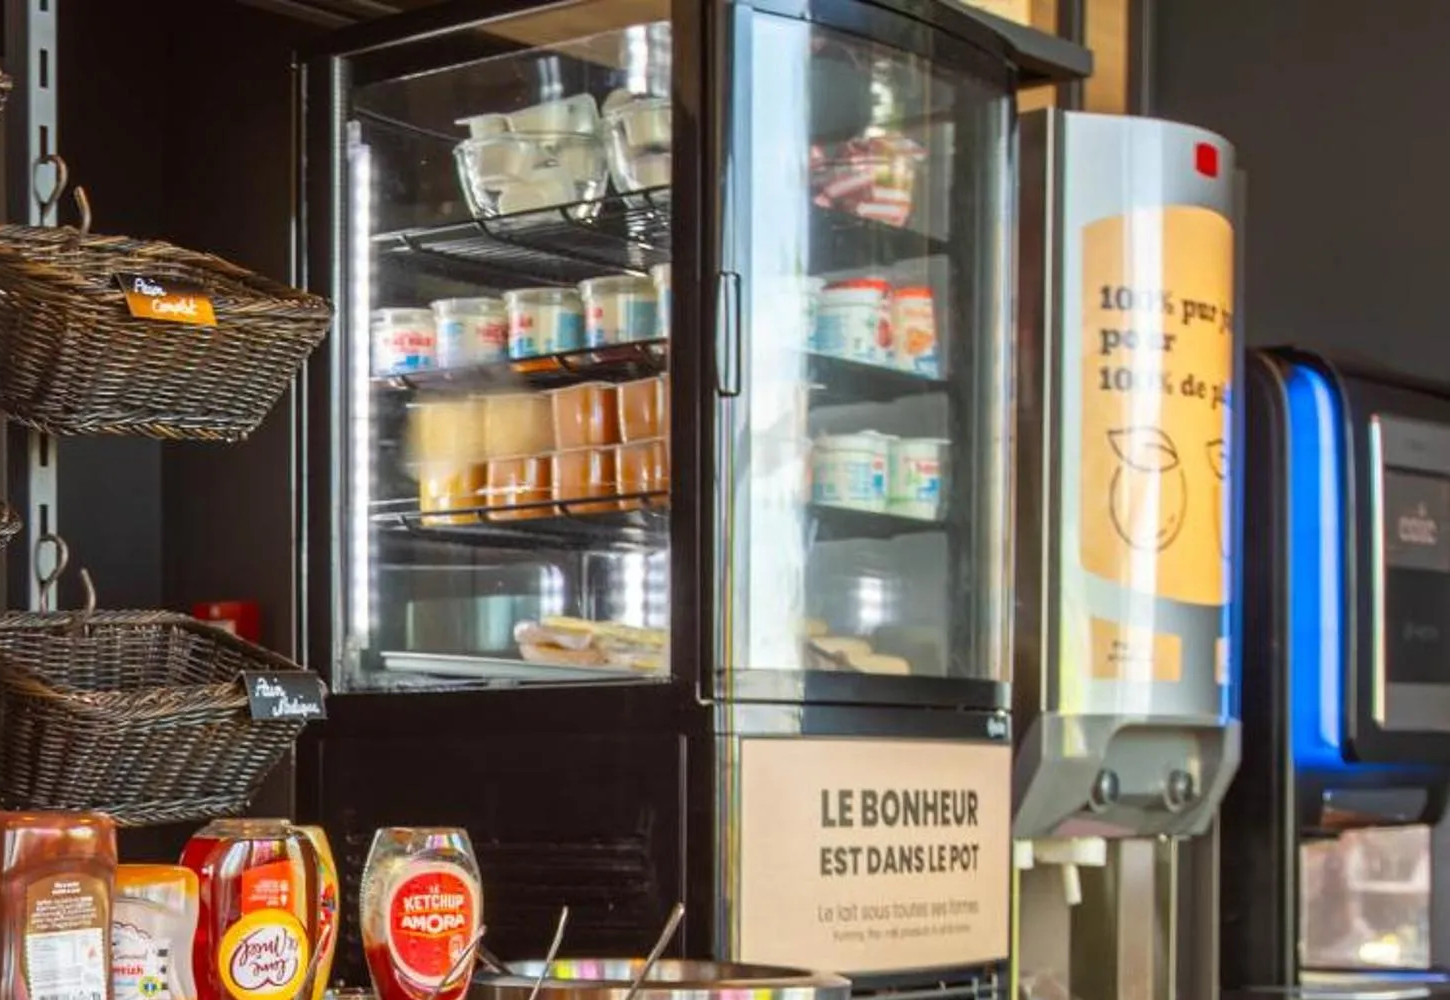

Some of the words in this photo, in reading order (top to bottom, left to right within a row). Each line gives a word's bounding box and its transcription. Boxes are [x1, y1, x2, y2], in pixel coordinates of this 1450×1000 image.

[1100, 284, 1175, 315] 10%
[1181, 298, 1218, 326] pur
[1100, 327, 1176, 356] por
[1099, 365, 1174, 396] 10%
[1180, 372, 1206, 399] de
[820, 788, 855, 828] LE
[860, 788, 979, 828] BONHEUR
[819, 846, 863, 876] EST
[866, 845, 926, 876] DANS
[928, 844, 947, 873] LE
[949, 842, 979, 872] POT
[403, 893, 465, 912] KETCHUP
[401, 914, 466, 934] AMORA
